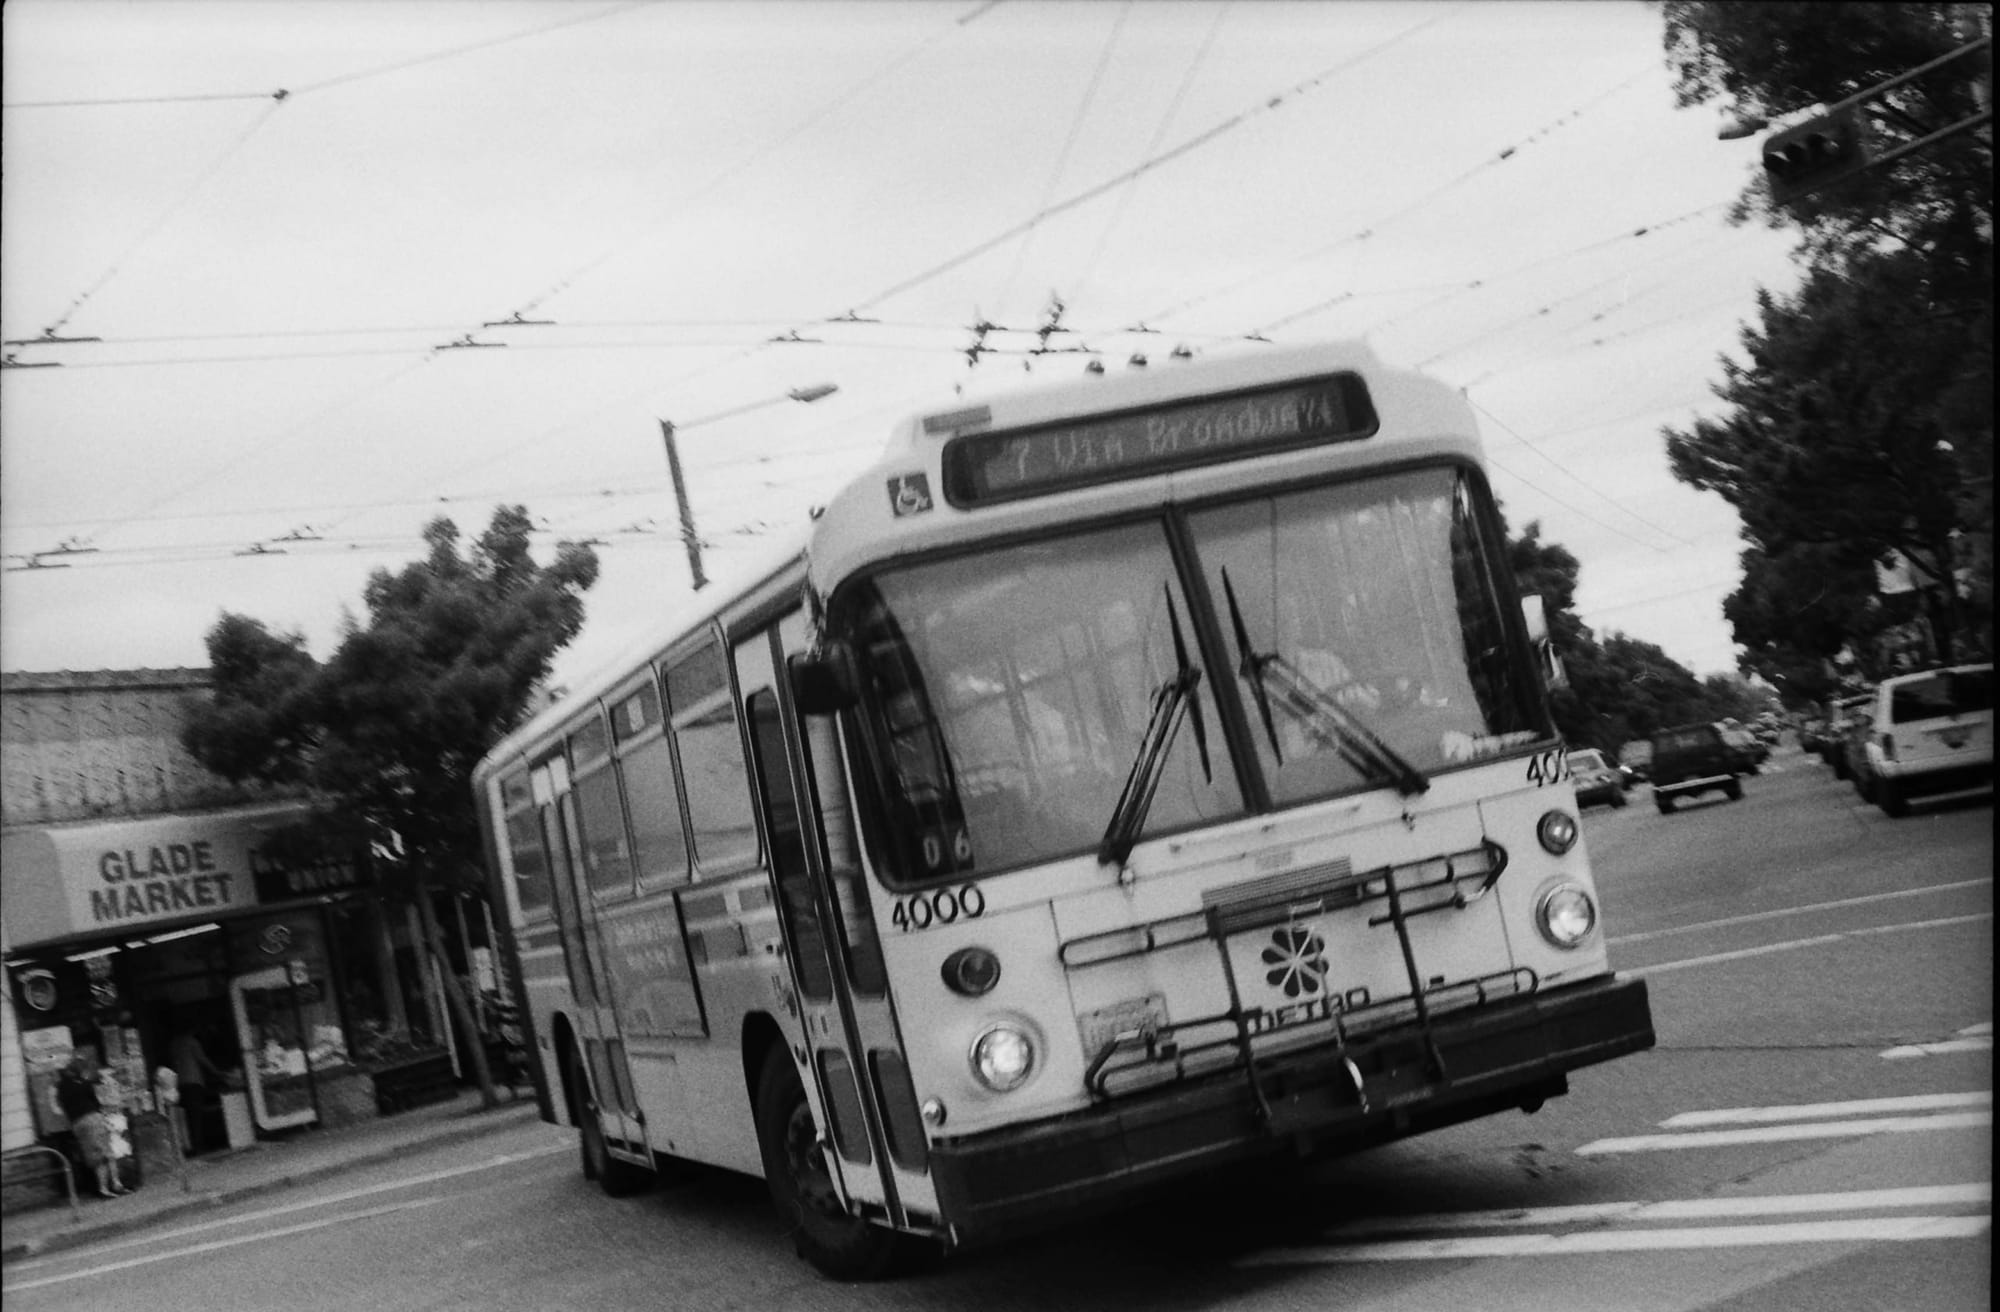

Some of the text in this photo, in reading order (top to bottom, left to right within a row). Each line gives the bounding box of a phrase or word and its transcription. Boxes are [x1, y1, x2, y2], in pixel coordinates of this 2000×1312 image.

[1010, 437, 1031, 480] 7
[99, 841, 217, 884] GLADE
[88, 870, 234, 921] MARKET
[892, 883, 986, 933] 4000
[1241, 986, 1371, 1036] METRO
